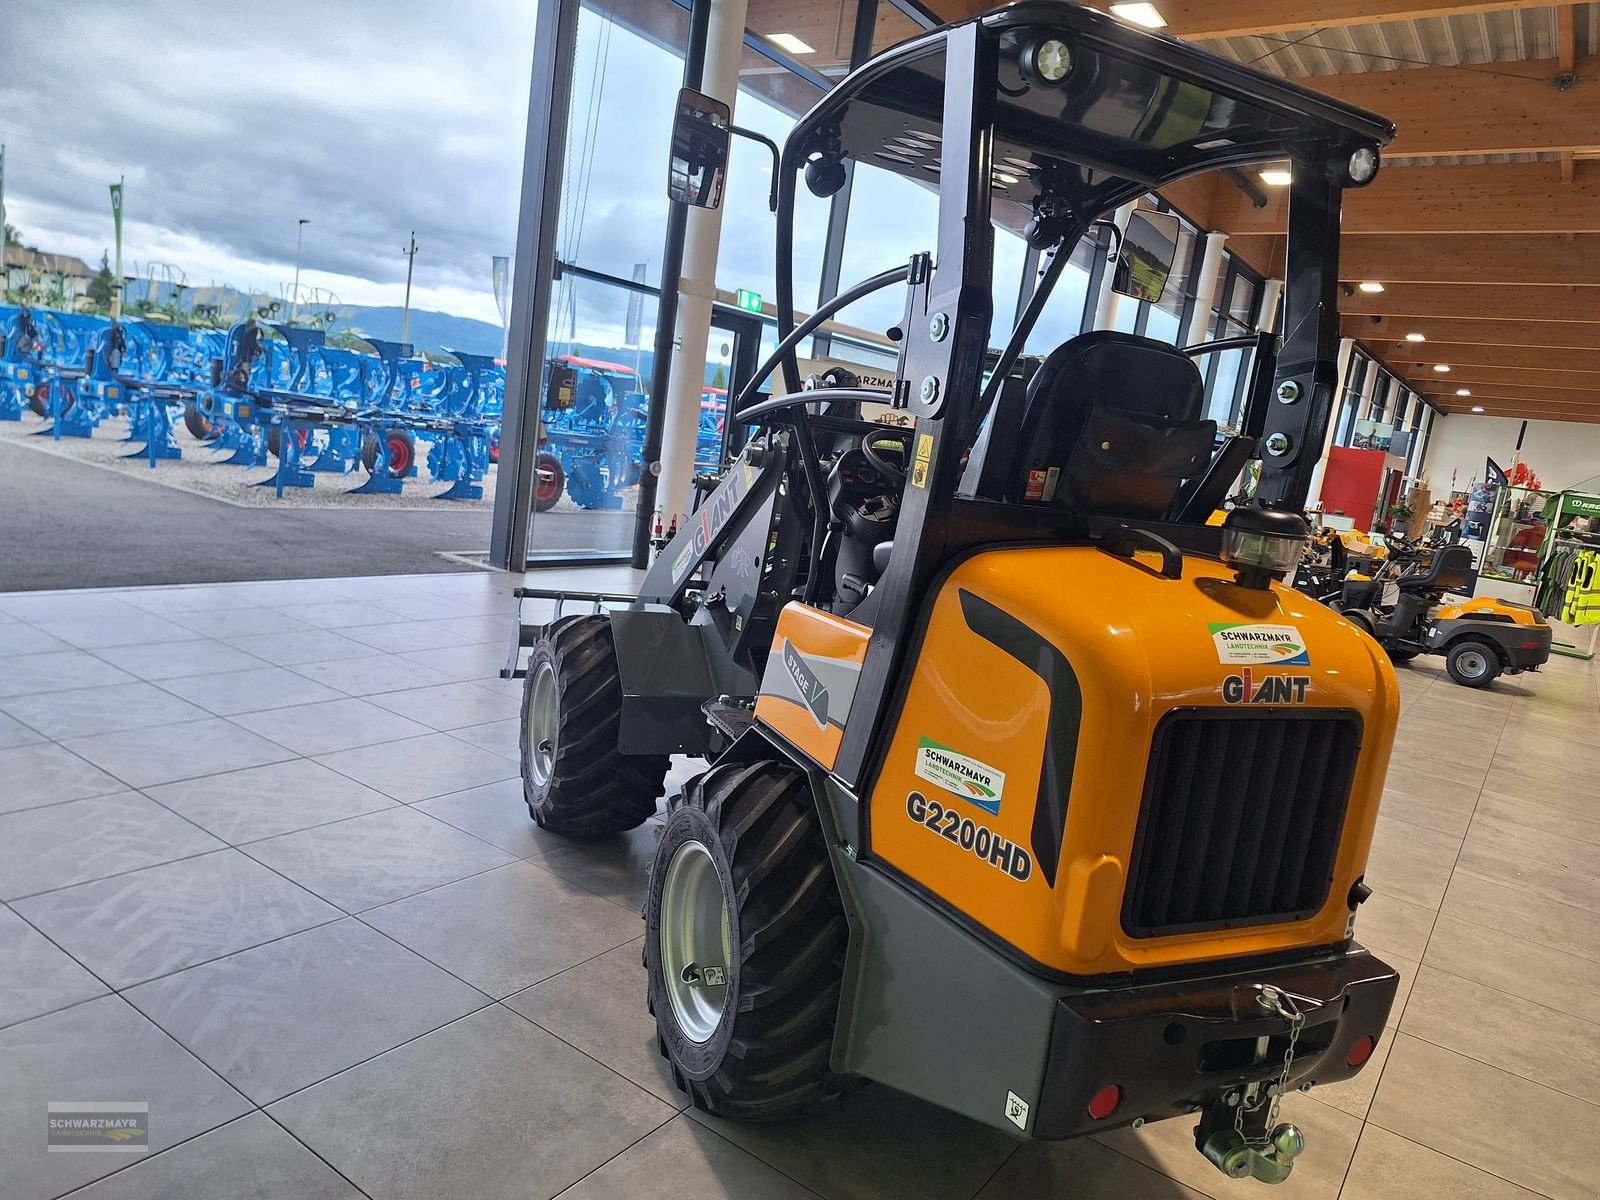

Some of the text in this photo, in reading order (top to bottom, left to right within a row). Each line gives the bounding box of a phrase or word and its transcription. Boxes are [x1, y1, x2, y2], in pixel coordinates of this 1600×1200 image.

[1220, 631, 1292, 643] SCHWARZMAYR
[1226, 642, 1270, 650] LANDTECHNIK
[787, 654, 810, 695] STAGE
[925, 748, 991, 787] SCHWARZMAYR
[925, 760, 963, 783] LANDTECHNIK
[905, 790, 1033, 883] G2200HD
